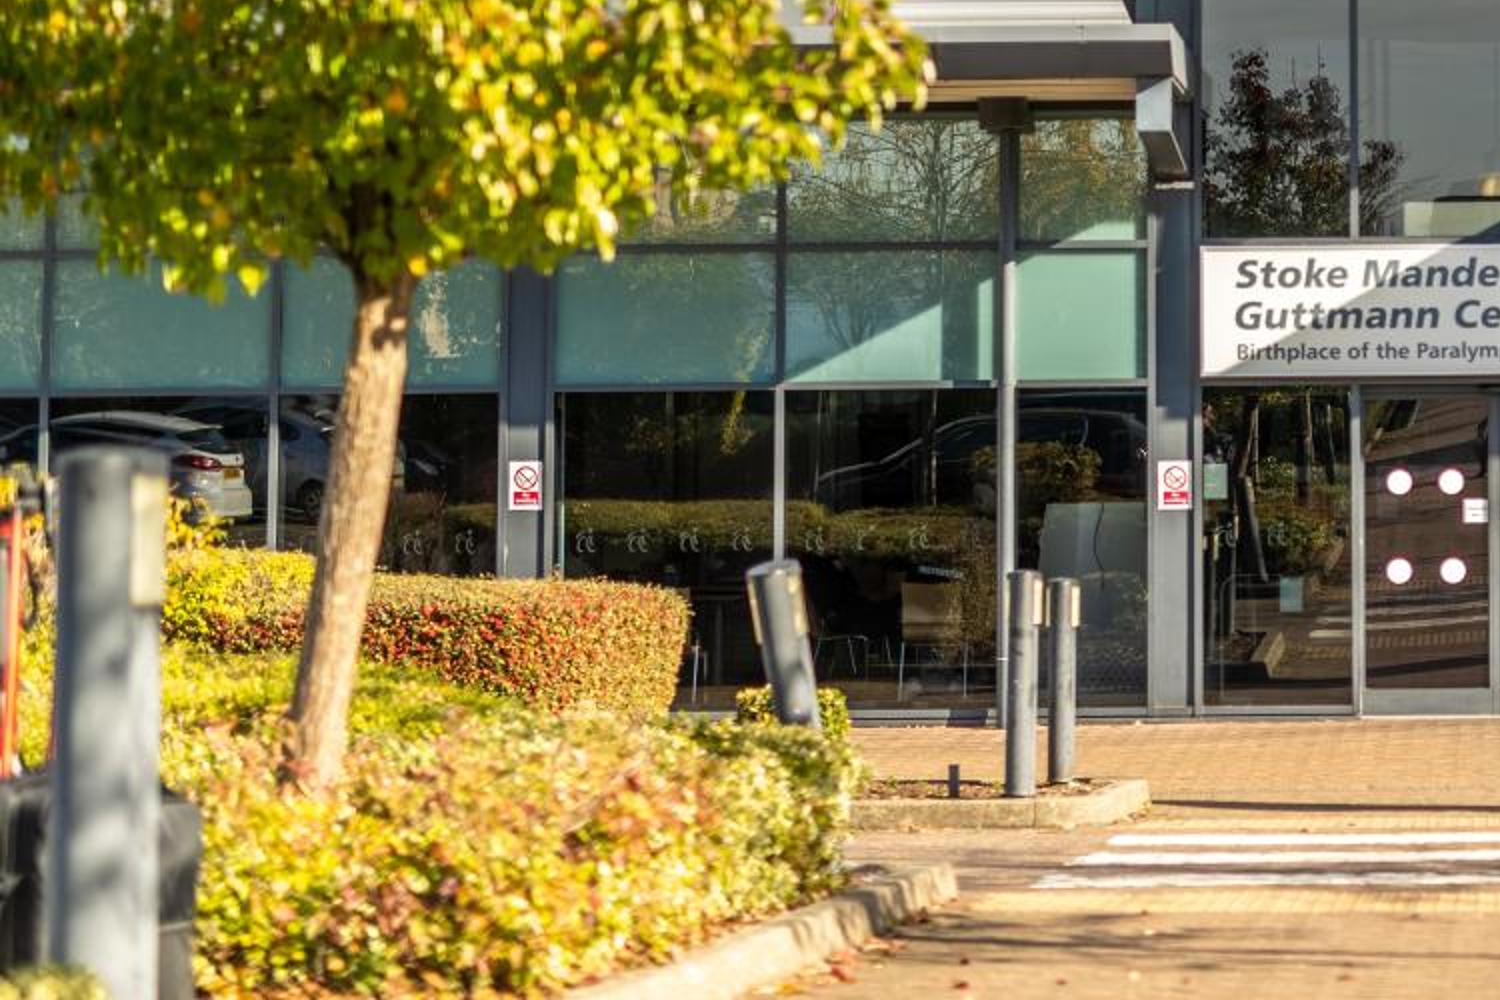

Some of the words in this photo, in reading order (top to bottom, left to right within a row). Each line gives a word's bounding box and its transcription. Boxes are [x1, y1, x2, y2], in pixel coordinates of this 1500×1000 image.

[1235, 258, 1348, 289] Stoke
[1234, 301, 1440, 330] Guttmann
[1236, 342, 1340, 363] Birthplace
[1348, 341, 1370, 360] of
[1376, 341, 1410, 360] the
